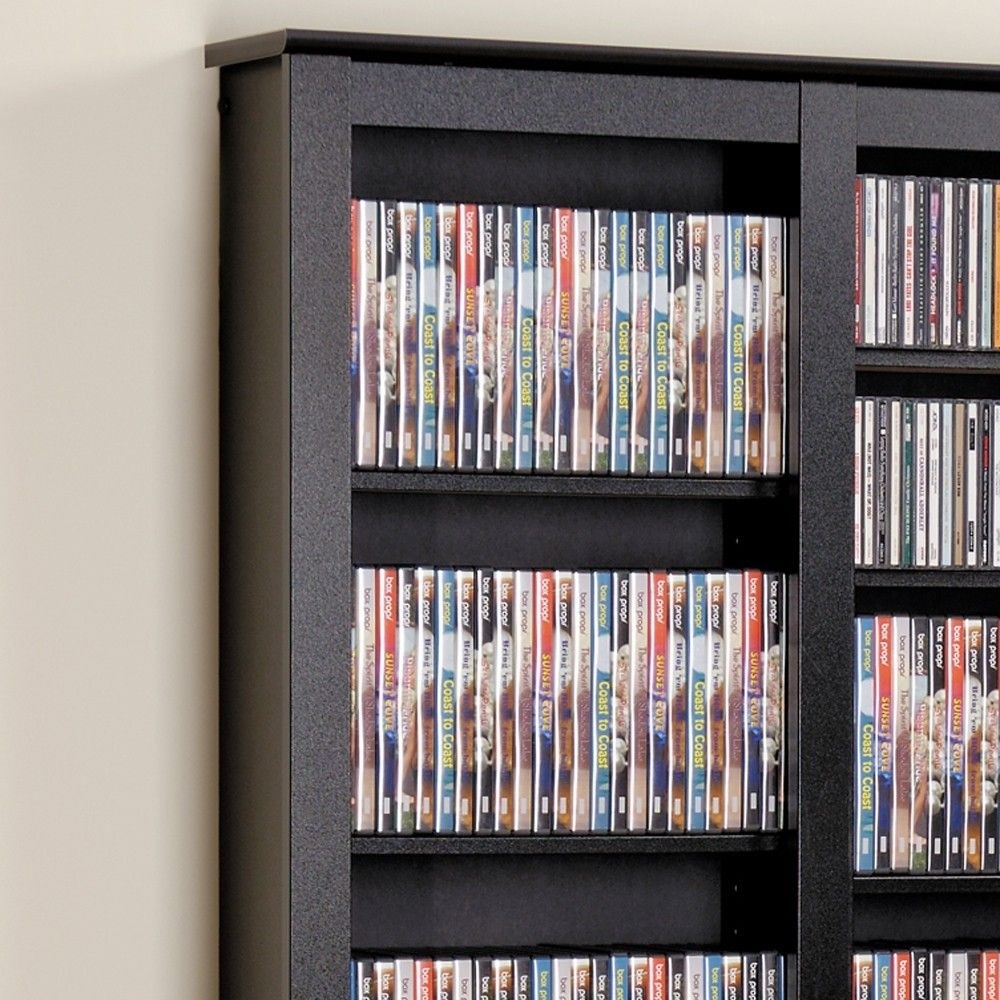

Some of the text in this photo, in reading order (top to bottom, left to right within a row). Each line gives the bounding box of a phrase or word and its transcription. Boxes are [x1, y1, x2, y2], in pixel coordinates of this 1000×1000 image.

[424, 315, 436, 349] Coast
[522, 318, 534, 352] Coast
[620, 321, 630, 355] Coast
[658, 322, 668, 356] Coast
[734, 324, 746, 357] Coast
[424, 370, 434, 403] Coast
[522, 372, 532, 405] Coast
[618, 375, 630, 408] Coast
[658, 376, 668, 409] Coast
[732, 378, 744, 410] Coast
[444, 678, 454, 713] Coast
[598, 680, 610, 714] Coast
[694, 680, 706, 714] Coast
[442, 734, 454, 768] Coast
[598, 735, 608, 768] Coast
[694, 735, 704, 768] Coast
[864, 724, 874, 757] Coast
[862, 777, 872, 809] Coast
